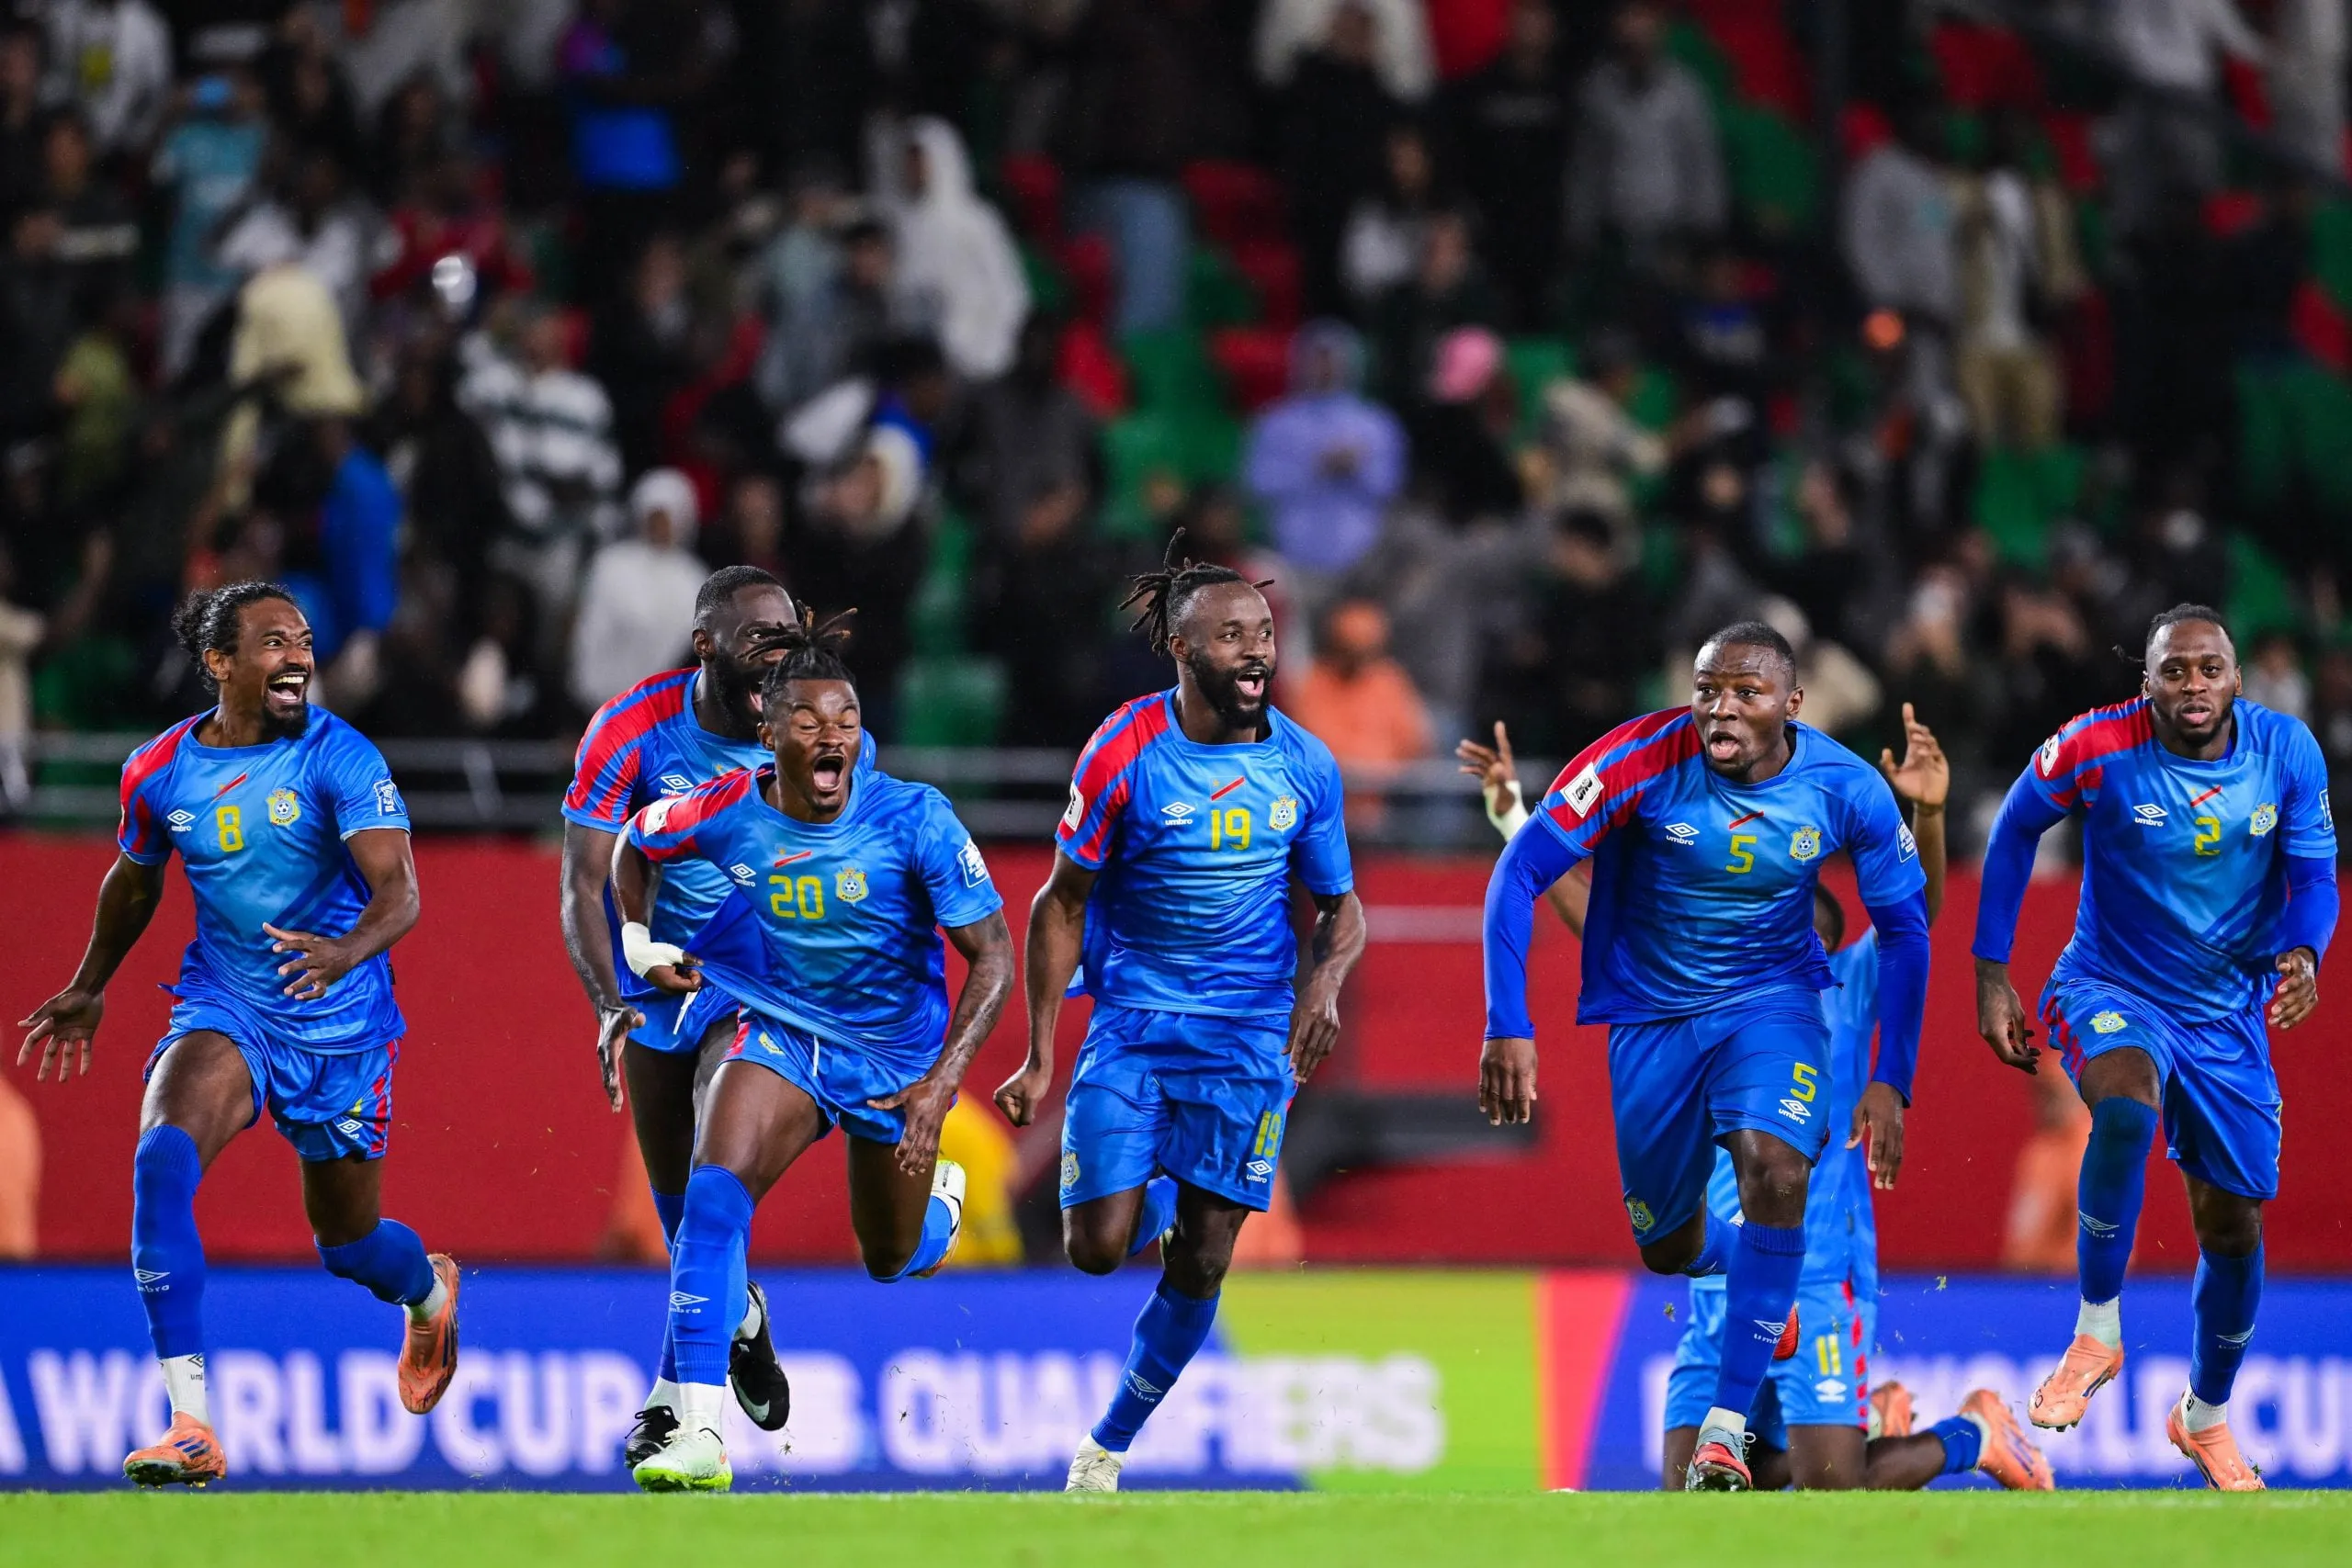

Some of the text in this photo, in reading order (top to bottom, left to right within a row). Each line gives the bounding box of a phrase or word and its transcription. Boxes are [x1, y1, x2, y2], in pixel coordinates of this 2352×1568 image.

[216, 806, 244, 852] 8
[1165, 818, 1193, 826] umbro
[1211, 808, 1251, 851] 19
[2134, 817, 2164, 828] umbro
[1666, 834, 1695, 846] umbro
[2194, 817, 2221, 855] 2
[1725, 834, 1758, 874] 5
[734, 878, 756, 887] umbro
[768, 874, 825, 919] 20
[1790, 1062, 1818, 1102] 5
[1778, 1108, 1805, 1124] umbro
[1254, 1111, 1282, 1157] 19
[1246, 1174, 1267, 1184] umbro
[137, 1284, 170, 1293] mbro
[670, 1305, 702, 1314] mbro
[1753, 1333, 1781, 1345] umb
[1816, 1334, 1842, 1376] 11
[432, 1348, 647, 1475] CUP
